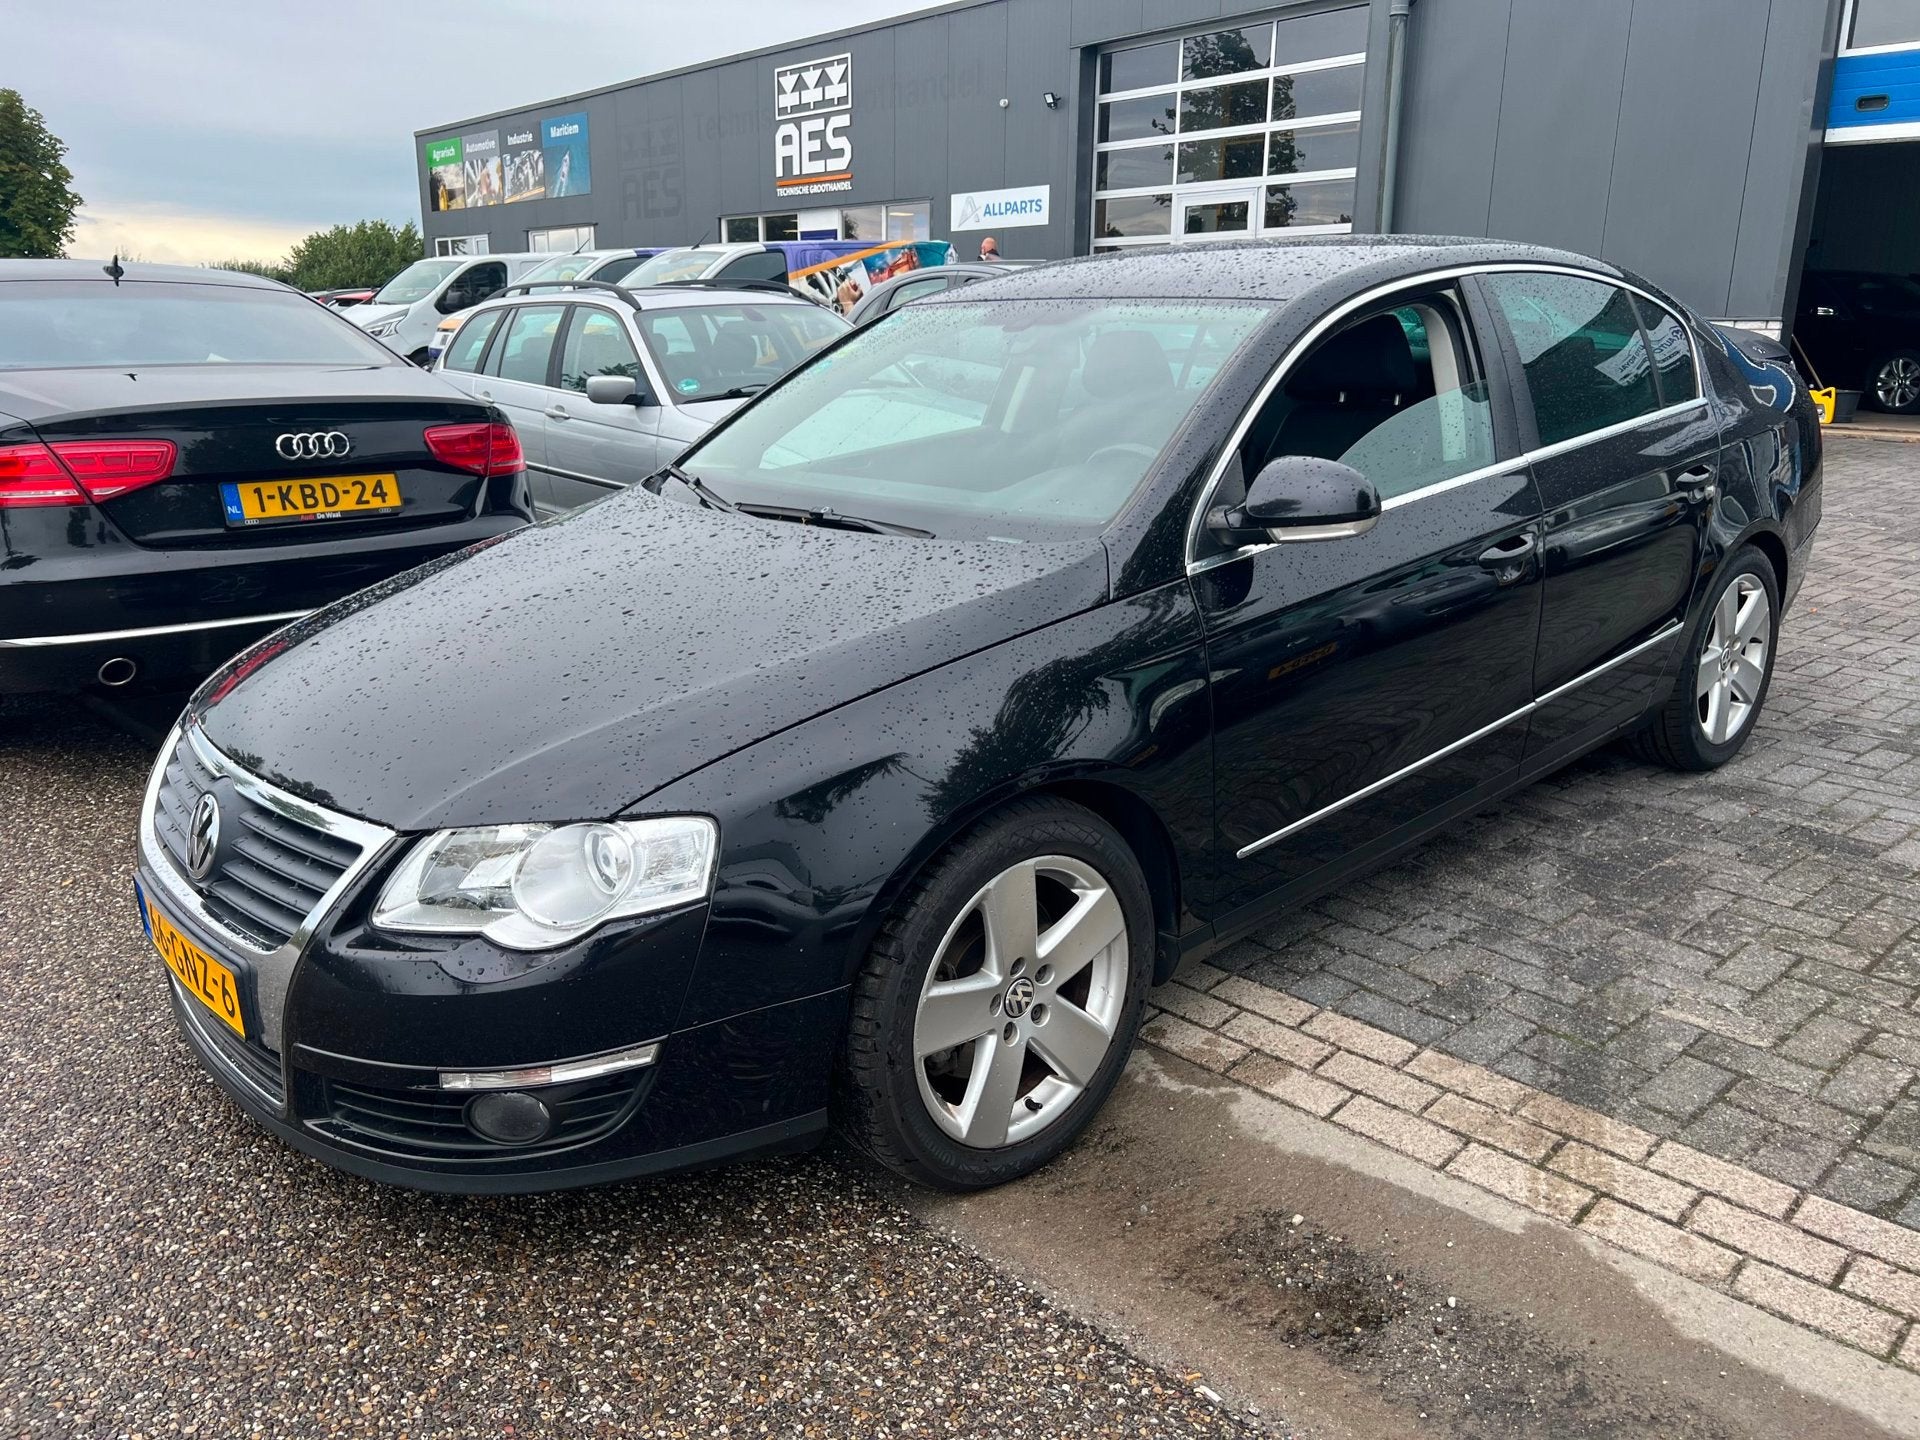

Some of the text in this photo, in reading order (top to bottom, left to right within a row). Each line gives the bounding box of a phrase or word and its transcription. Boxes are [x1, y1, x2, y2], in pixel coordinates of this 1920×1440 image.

[507, 131, 533, 145] Industrie
[550, 123, 579, 138] Maritiem
[432, 146, 456, 161] Agrarisch
[466, 139, 496, 153] Automotive
[775, 114, 852, 178] AES
[776, 181, 852, 197] TECHNISCHE GROOTHANDEL
[983, 198, 1043, 217] ALLPARTS
[253, 479, 388, 513] 1-KBD-24
[227, 505, 241, 514] NL
[149, 903, 236, 1019] 66-GNZ-6
